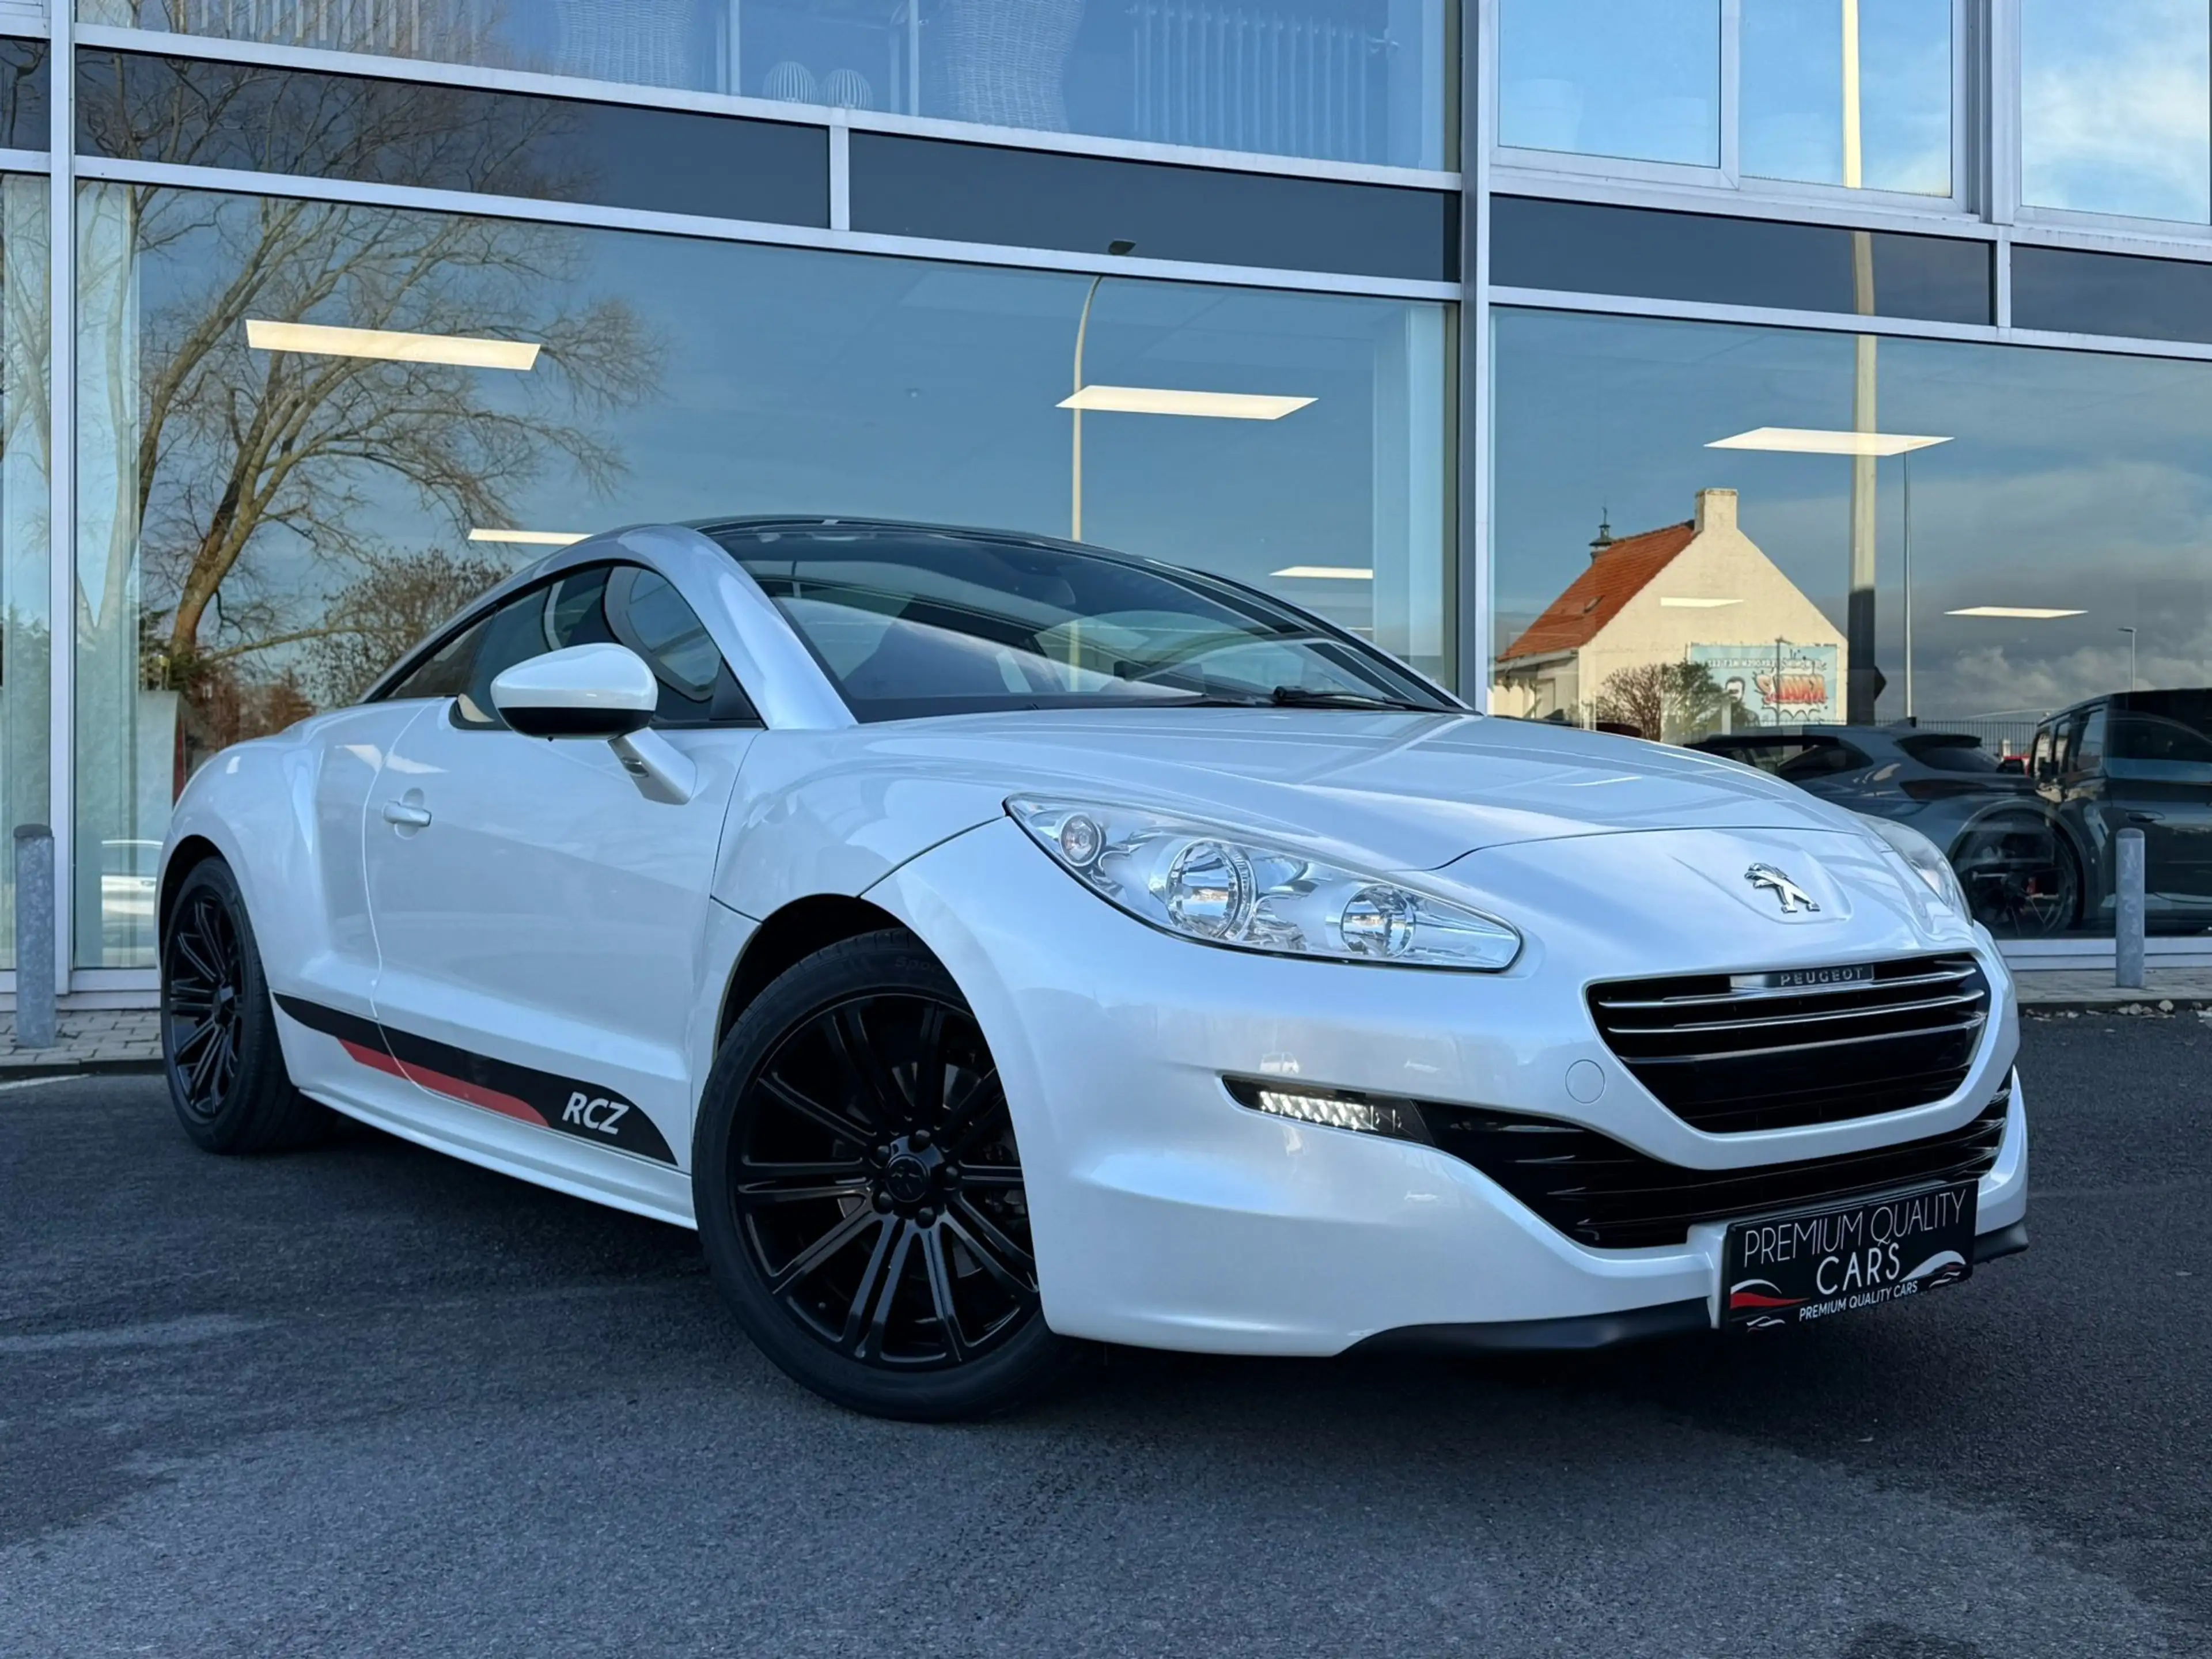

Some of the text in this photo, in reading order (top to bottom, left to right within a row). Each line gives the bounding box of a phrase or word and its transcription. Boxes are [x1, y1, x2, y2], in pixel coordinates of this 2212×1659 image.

[1781, 967, 1863, 986] PEUGEOT
[562, 1091, 629, 1135] RCZ
[1744, 1189, 1967, 1267] PREMIUM QUALITY
[1816, 1243, 1900, 1295] CARS
[1799, 1281, 1918, 1321] PREMIUM QUALITY CARS
